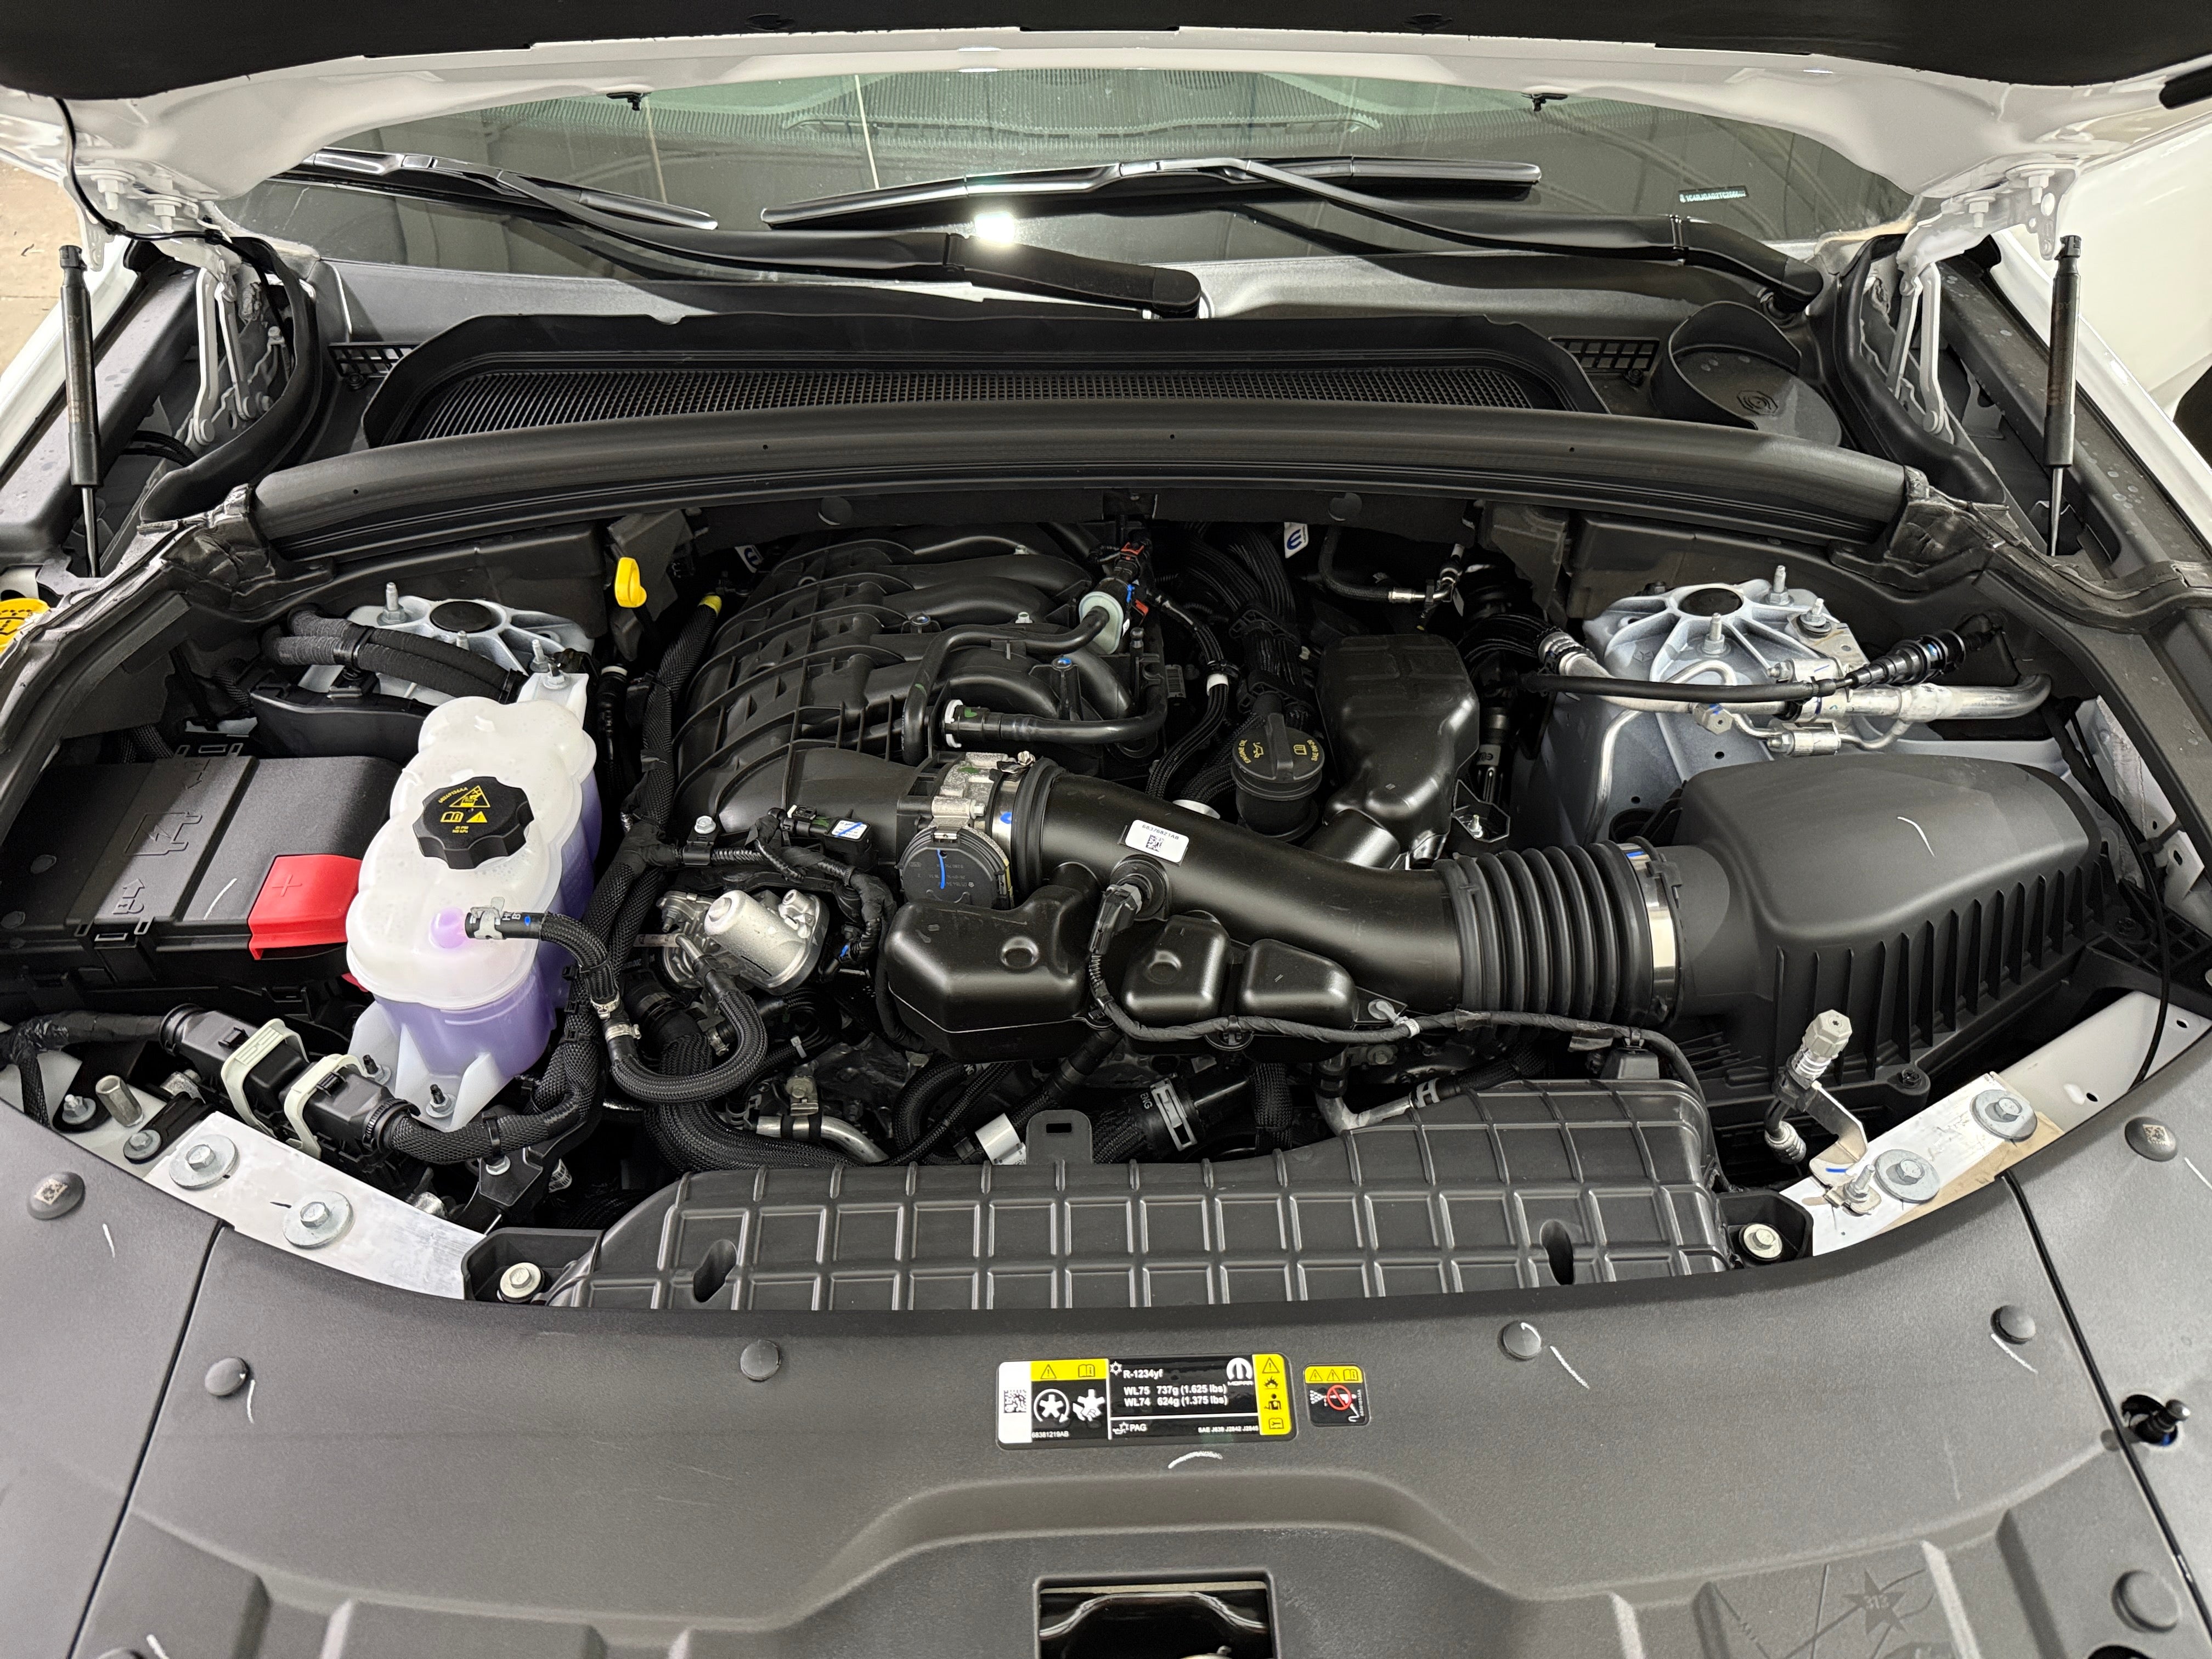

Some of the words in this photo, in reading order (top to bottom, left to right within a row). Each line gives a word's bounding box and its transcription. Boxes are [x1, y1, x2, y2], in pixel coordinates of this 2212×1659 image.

[1238, 747, 1251, 764] ENGINE
[1140, 1092, 1153, 1109] ENG
[1122, 1369, 1164, 1380] R-1234yf
[1124, 1386, 1150, 1396] WL75
[1156, 1385, 1180, 1396] 737g
[1181, 1384, 1207, 1396] (1.625
[1210, 1384, 1227, 1395] lbs)
[1124, 1397, 1151, 1407] WL74
[1157, 1397, 1180, 1407] 624g
[1181, 1396, 1209, 1407] (1.375
[1211, 1395, 1228, 1406] lbs)
[1130, 1423, 1148, 1432] PAG
